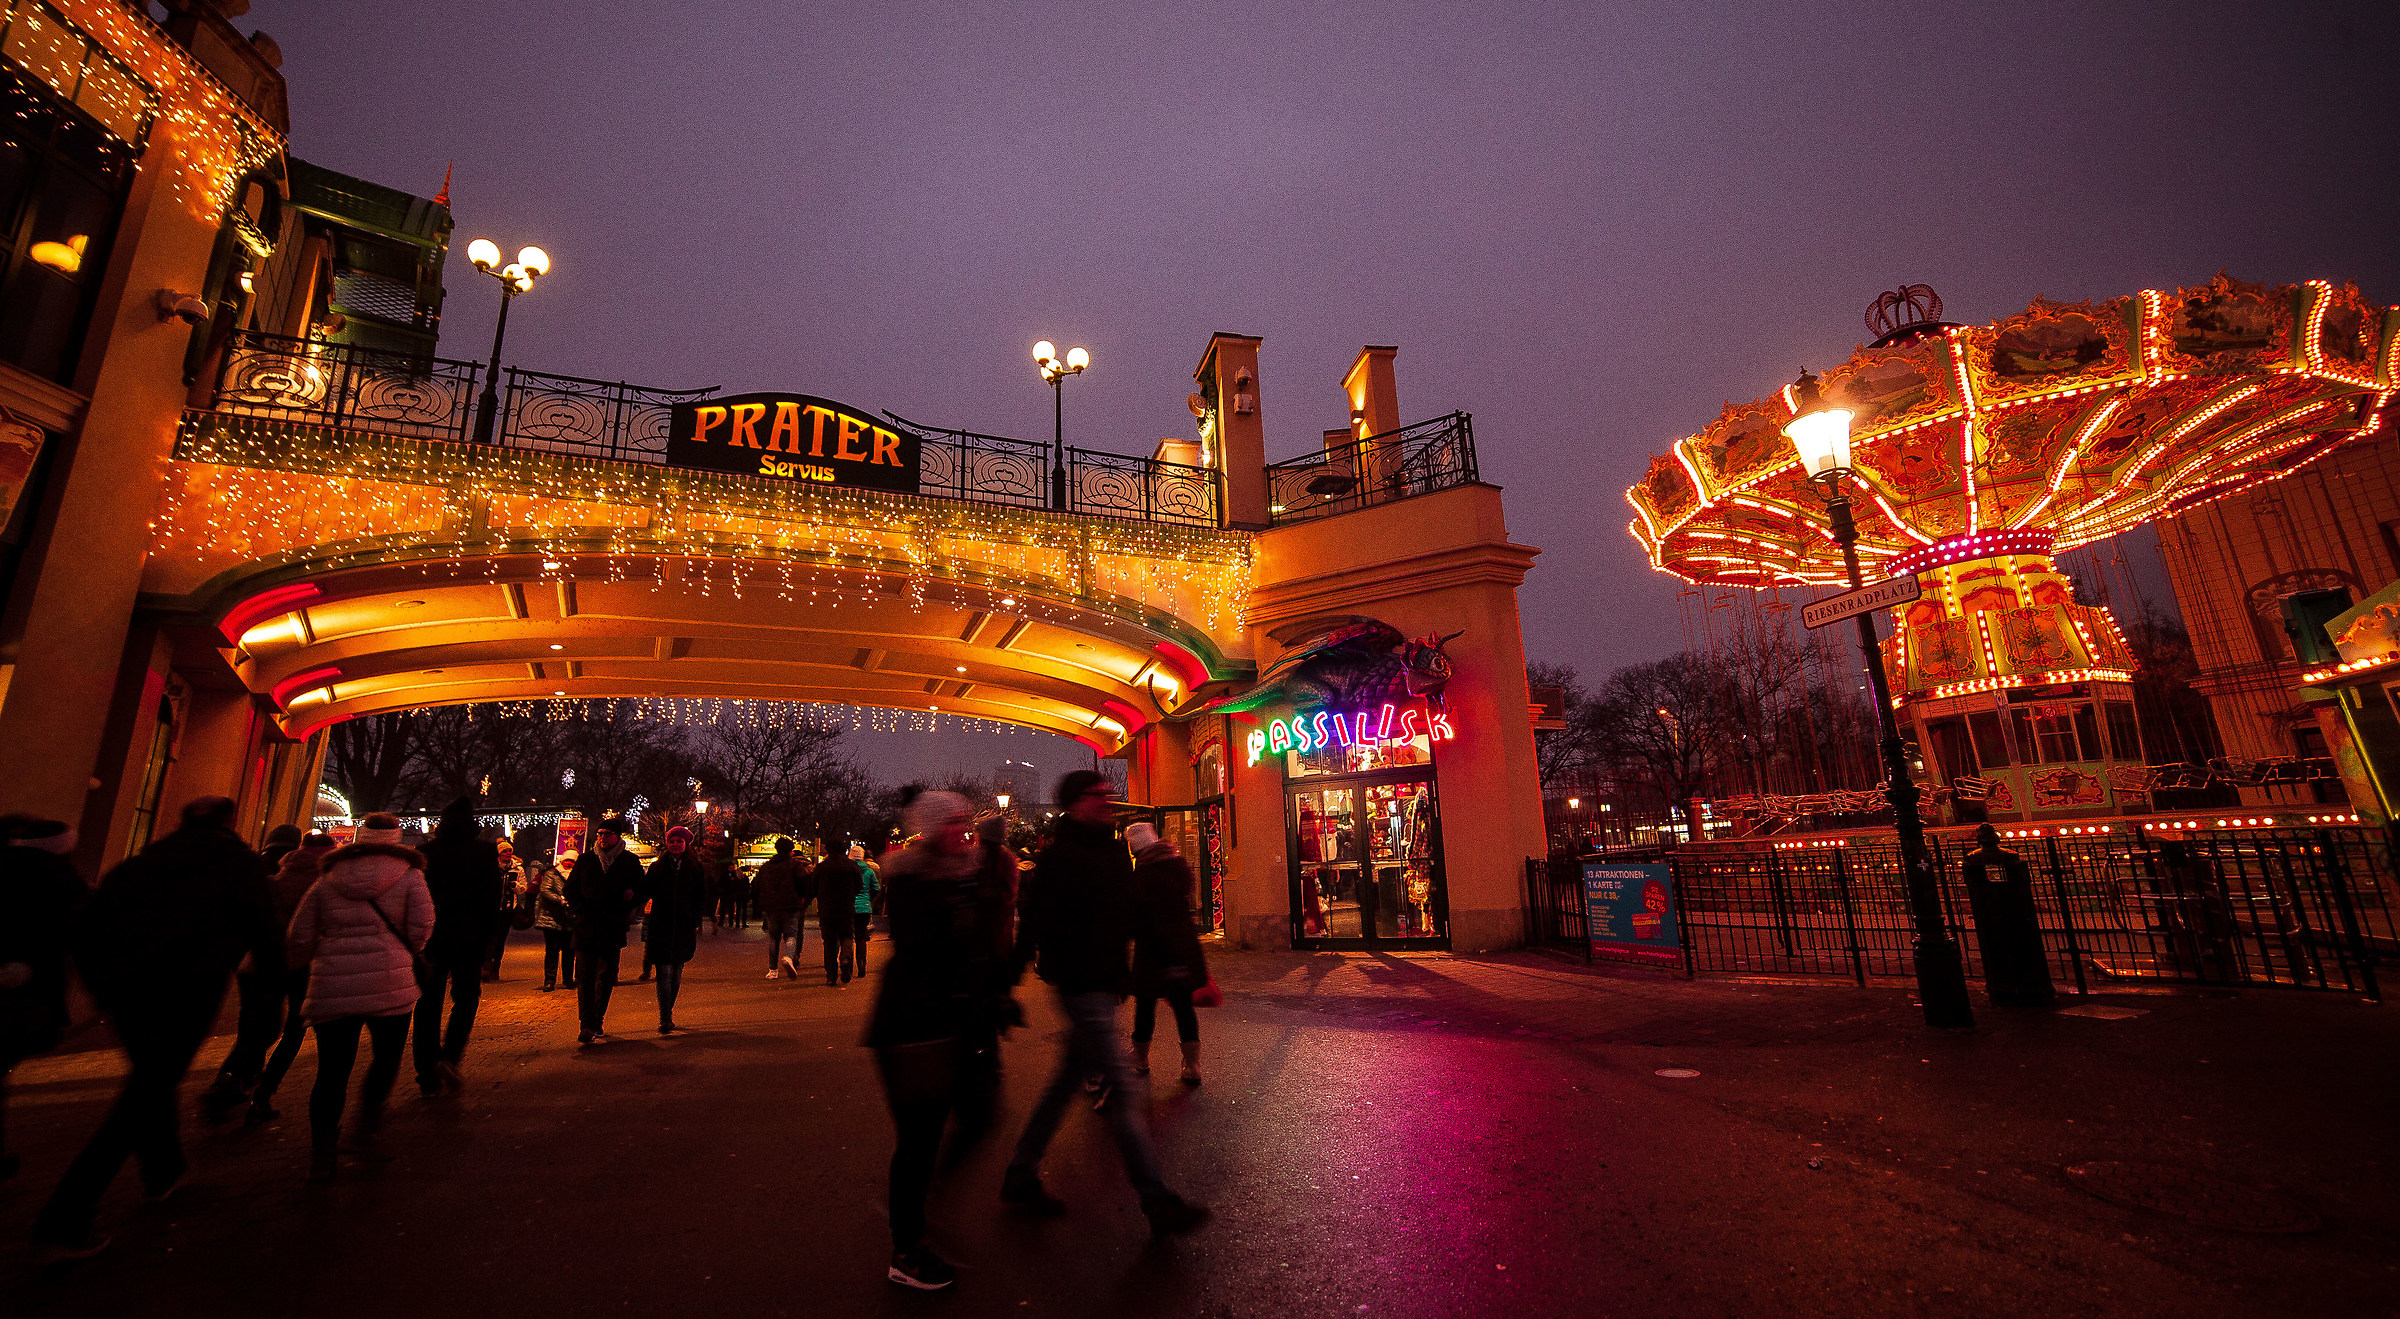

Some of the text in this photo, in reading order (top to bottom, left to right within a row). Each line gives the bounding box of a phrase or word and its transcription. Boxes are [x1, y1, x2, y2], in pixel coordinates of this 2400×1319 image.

[691, 401, 904, 467] PRATER
[758, 454, 836, 482] Servus
[1807, 582, 1915, 622] RIESENRADPLATZ
[1247, 704, 1454, 768] PASSILISK
[1587, 870, 1594, 879] 13
[1595, 870, 1644, 879] ATTRAKTIONEN
[1593, 881, 1613, 889] KARTE
[1588, 891, 1602, 899] NUR
